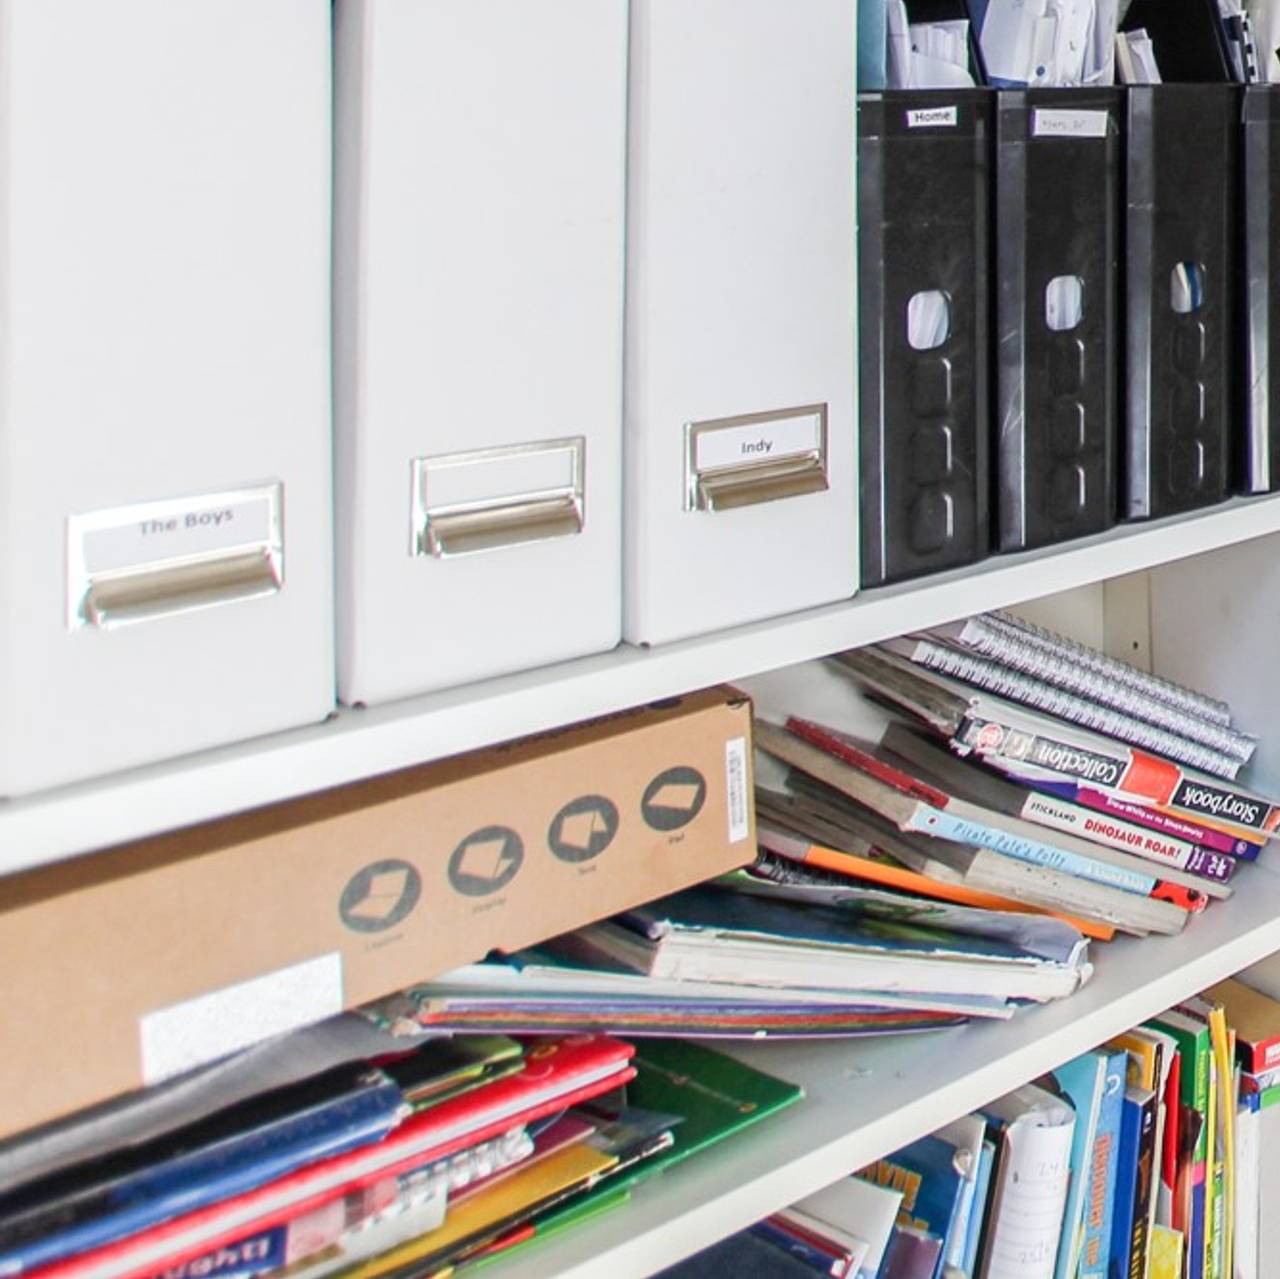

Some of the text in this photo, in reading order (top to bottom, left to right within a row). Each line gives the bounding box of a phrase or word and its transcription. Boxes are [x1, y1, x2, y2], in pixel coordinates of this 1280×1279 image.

[915, 110, 951, 123] Home
[740, 437, 774, 456] Indy
[138, 506, 235, 537] The Boys
[1038, 740, 1263, 825] Storybook Collection
[952, 820, 993, 845] Pirate
[1083, 814, 1143, 849] DINOSAUR
[1144, 836, 1181, 860] ROAR!
